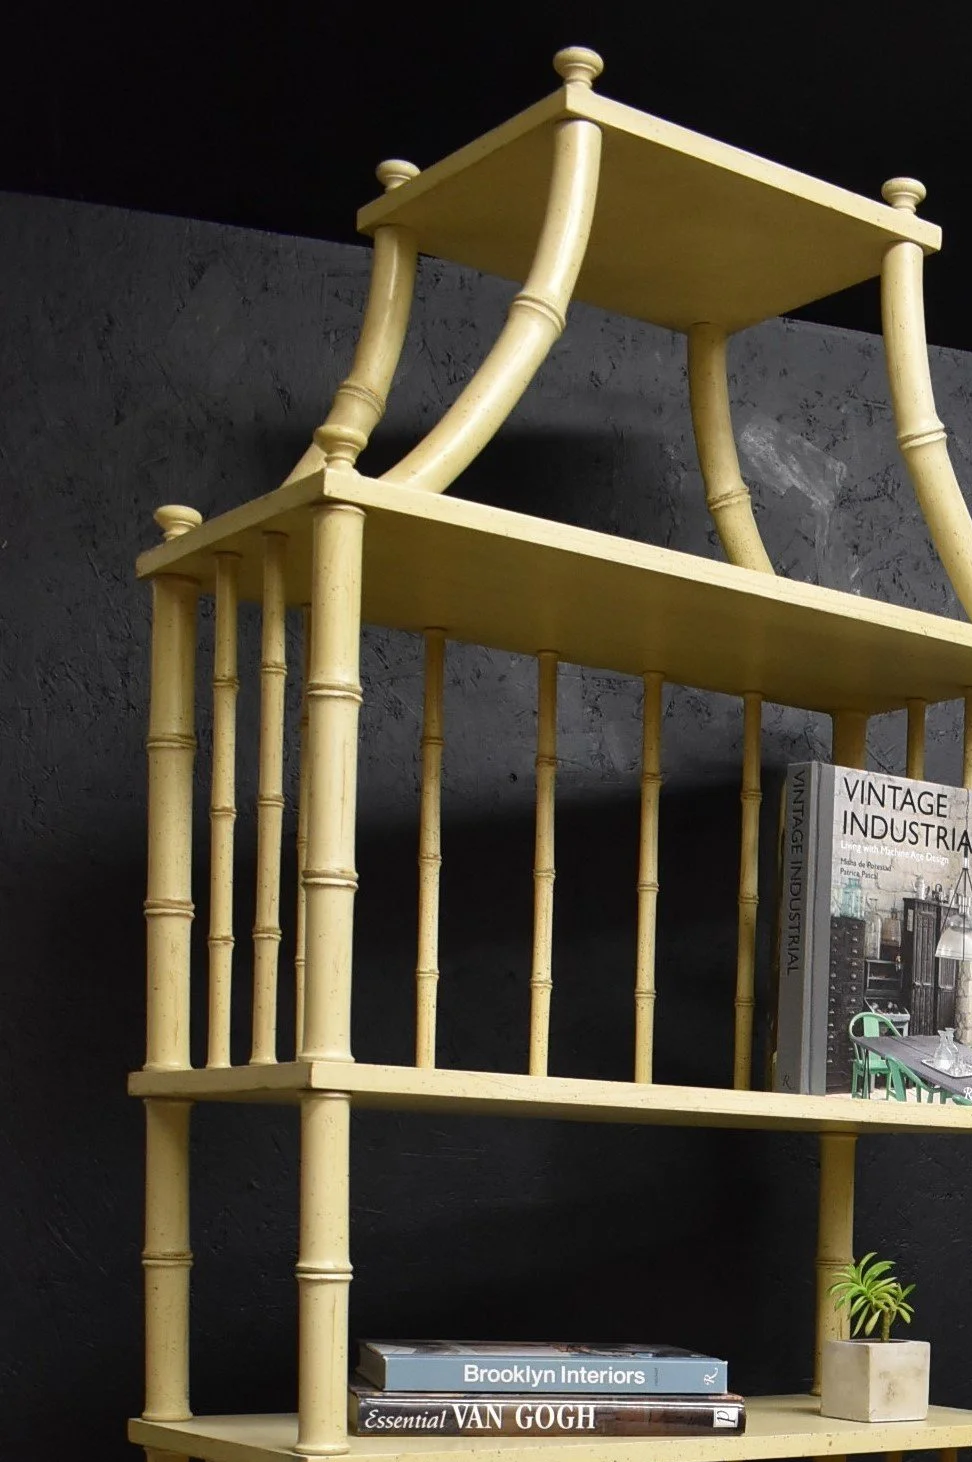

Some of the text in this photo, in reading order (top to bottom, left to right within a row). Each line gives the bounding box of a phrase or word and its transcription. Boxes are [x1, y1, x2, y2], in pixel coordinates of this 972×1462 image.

[843, 776, 949, 819] VINTAGE
[925, 852, 950, 866] Design
[786, 770, 805, 976] VINTAGE INDUSTRIAL
[463, 1364, 556, 1387] Brooklyn
[561, 1365, 646, 1385] Interiors
[364, 1403, 596, 1430] Essential VAN GOGH
